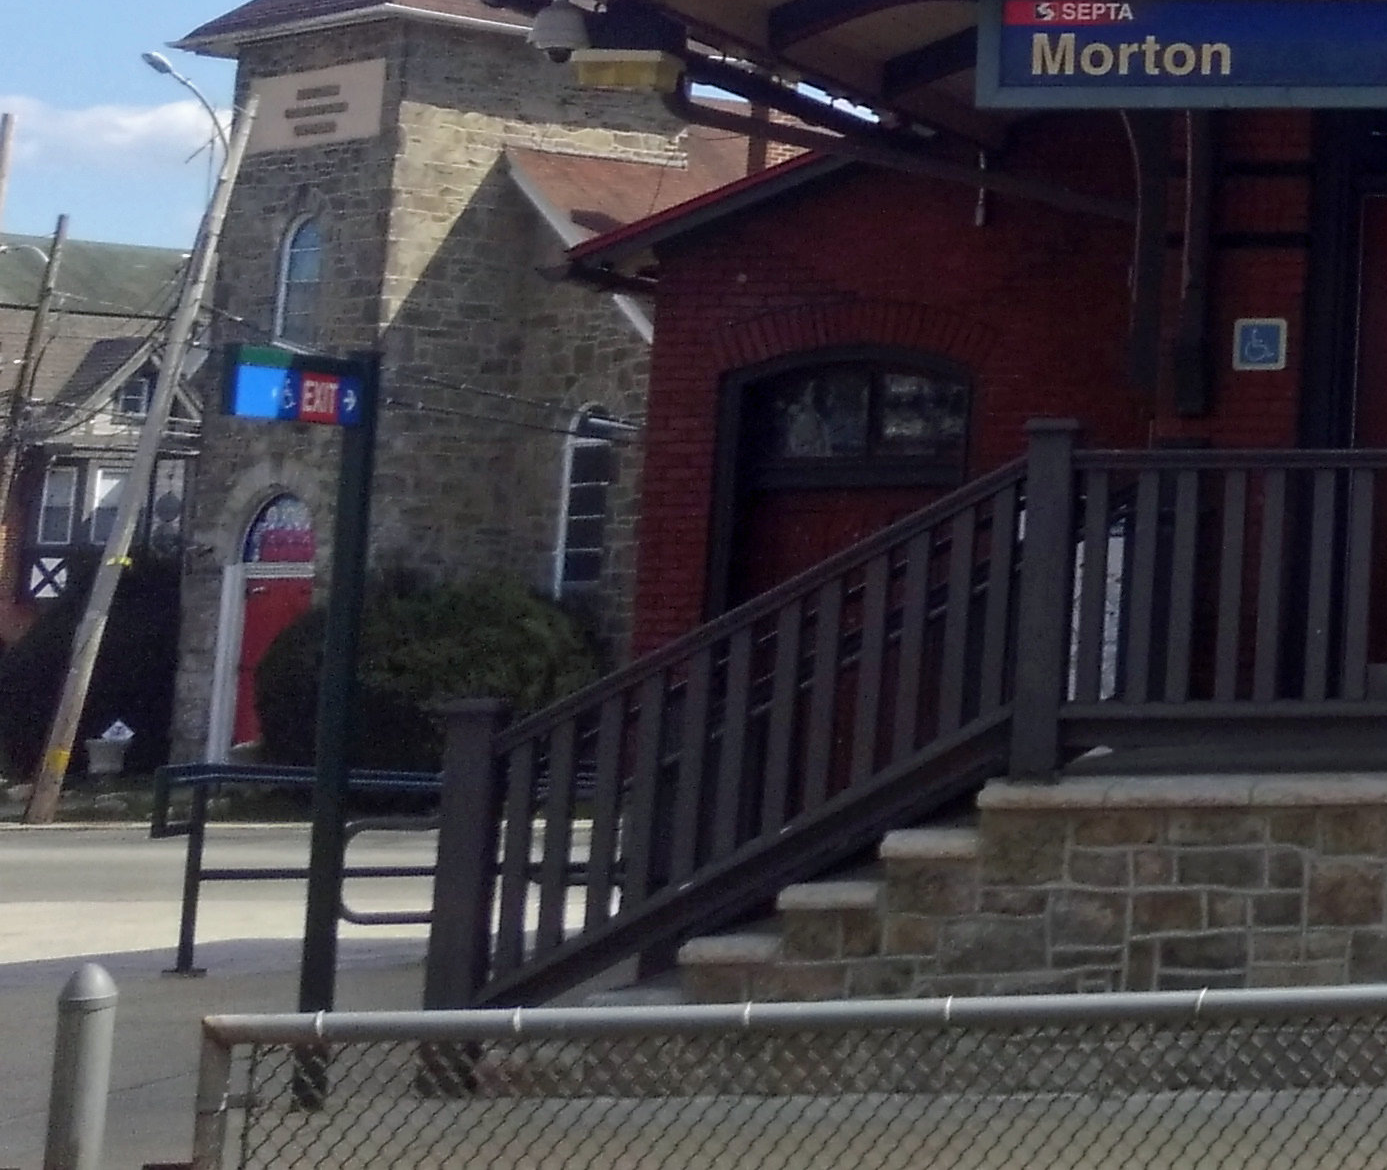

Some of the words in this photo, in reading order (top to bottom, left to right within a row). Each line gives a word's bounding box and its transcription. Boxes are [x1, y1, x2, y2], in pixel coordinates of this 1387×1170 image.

[1061, 2, 1134, 21] SEPTA
[1032, 32, 1232, 75] Morton
[303, 379, 339, 414] EXIT
